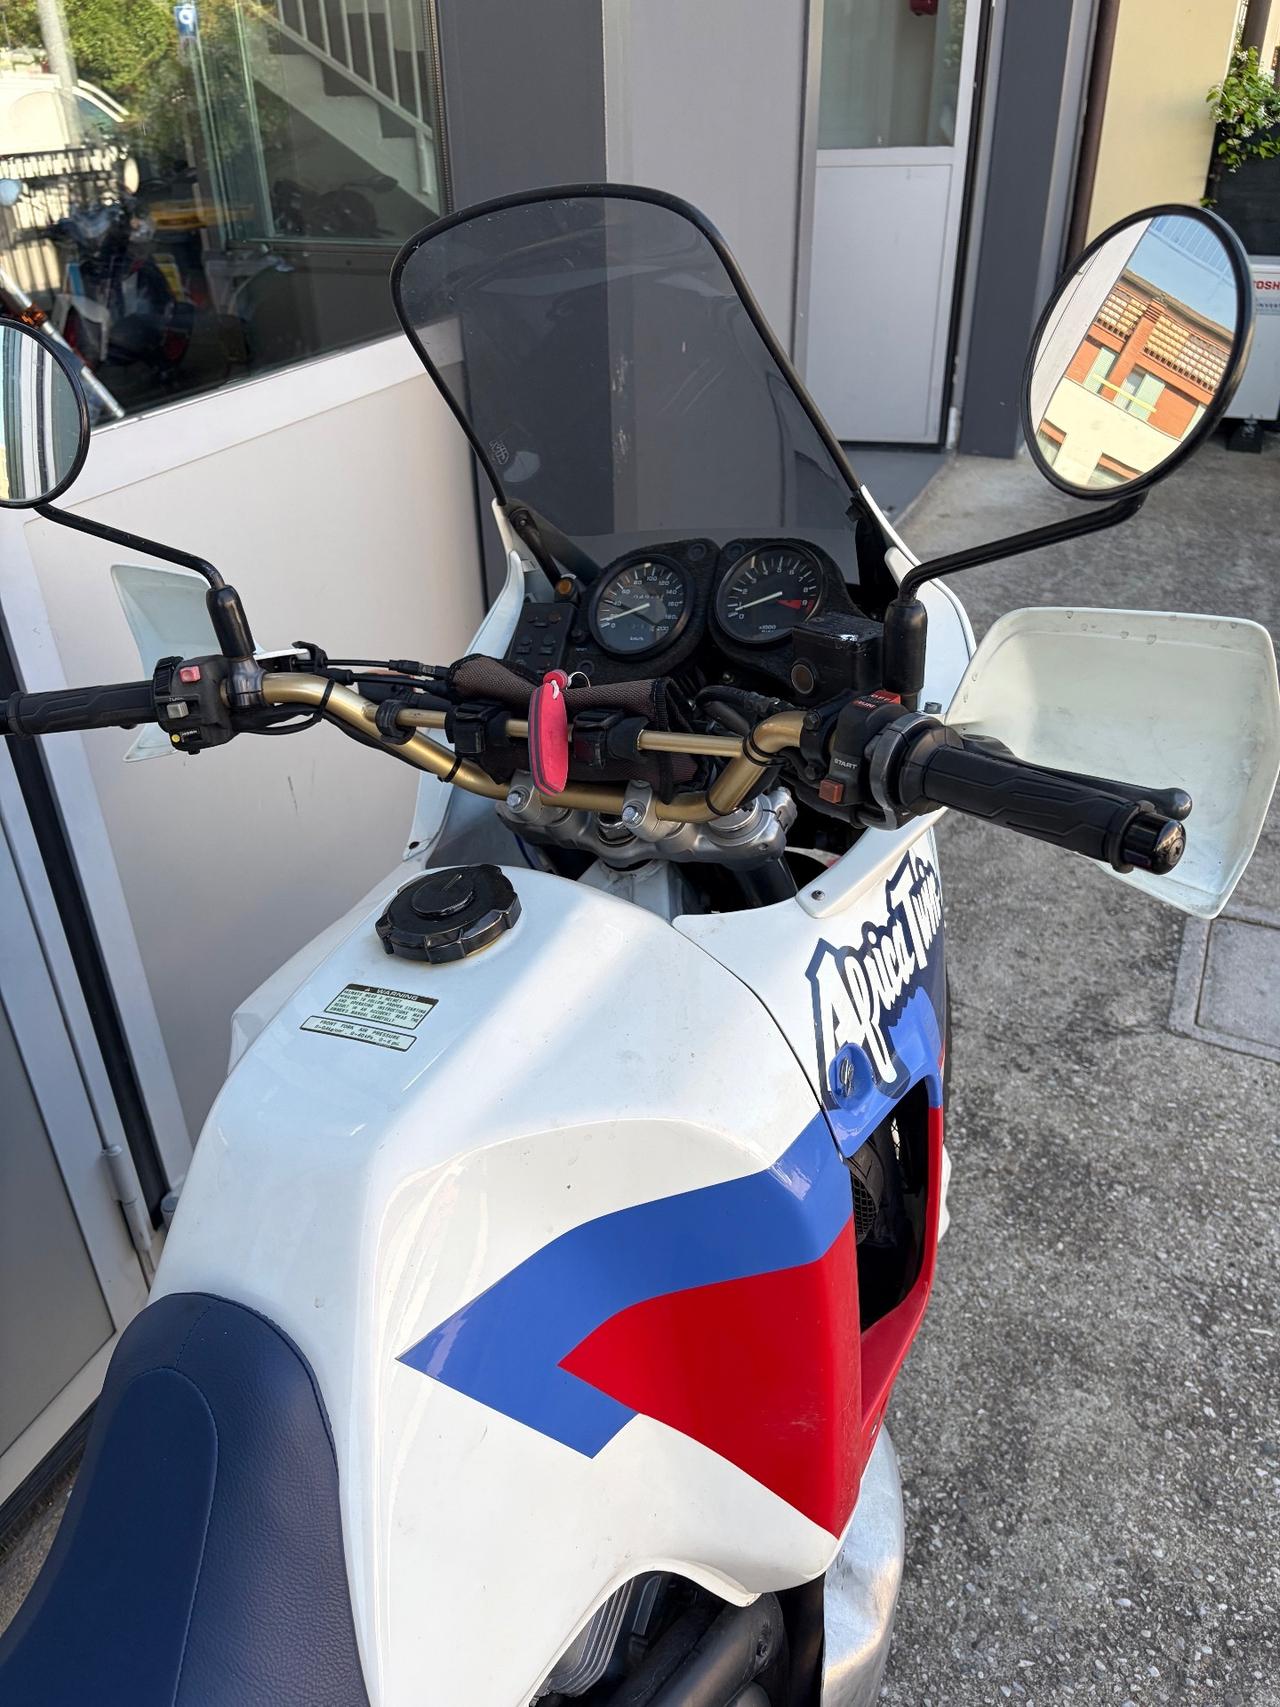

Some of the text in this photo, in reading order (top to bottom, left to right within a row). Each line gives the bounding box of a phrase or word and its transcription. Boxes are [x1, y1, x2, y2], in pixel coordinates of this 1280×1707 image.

[834, 758, 858, 770] START
[810, 856, 942, 1094] Africa Twin
[376, 988, 418, 1000] WARNING
[320, 1019, 337, 1027] FRONT
[372, 1030, 401, 1040] PRESSURE
